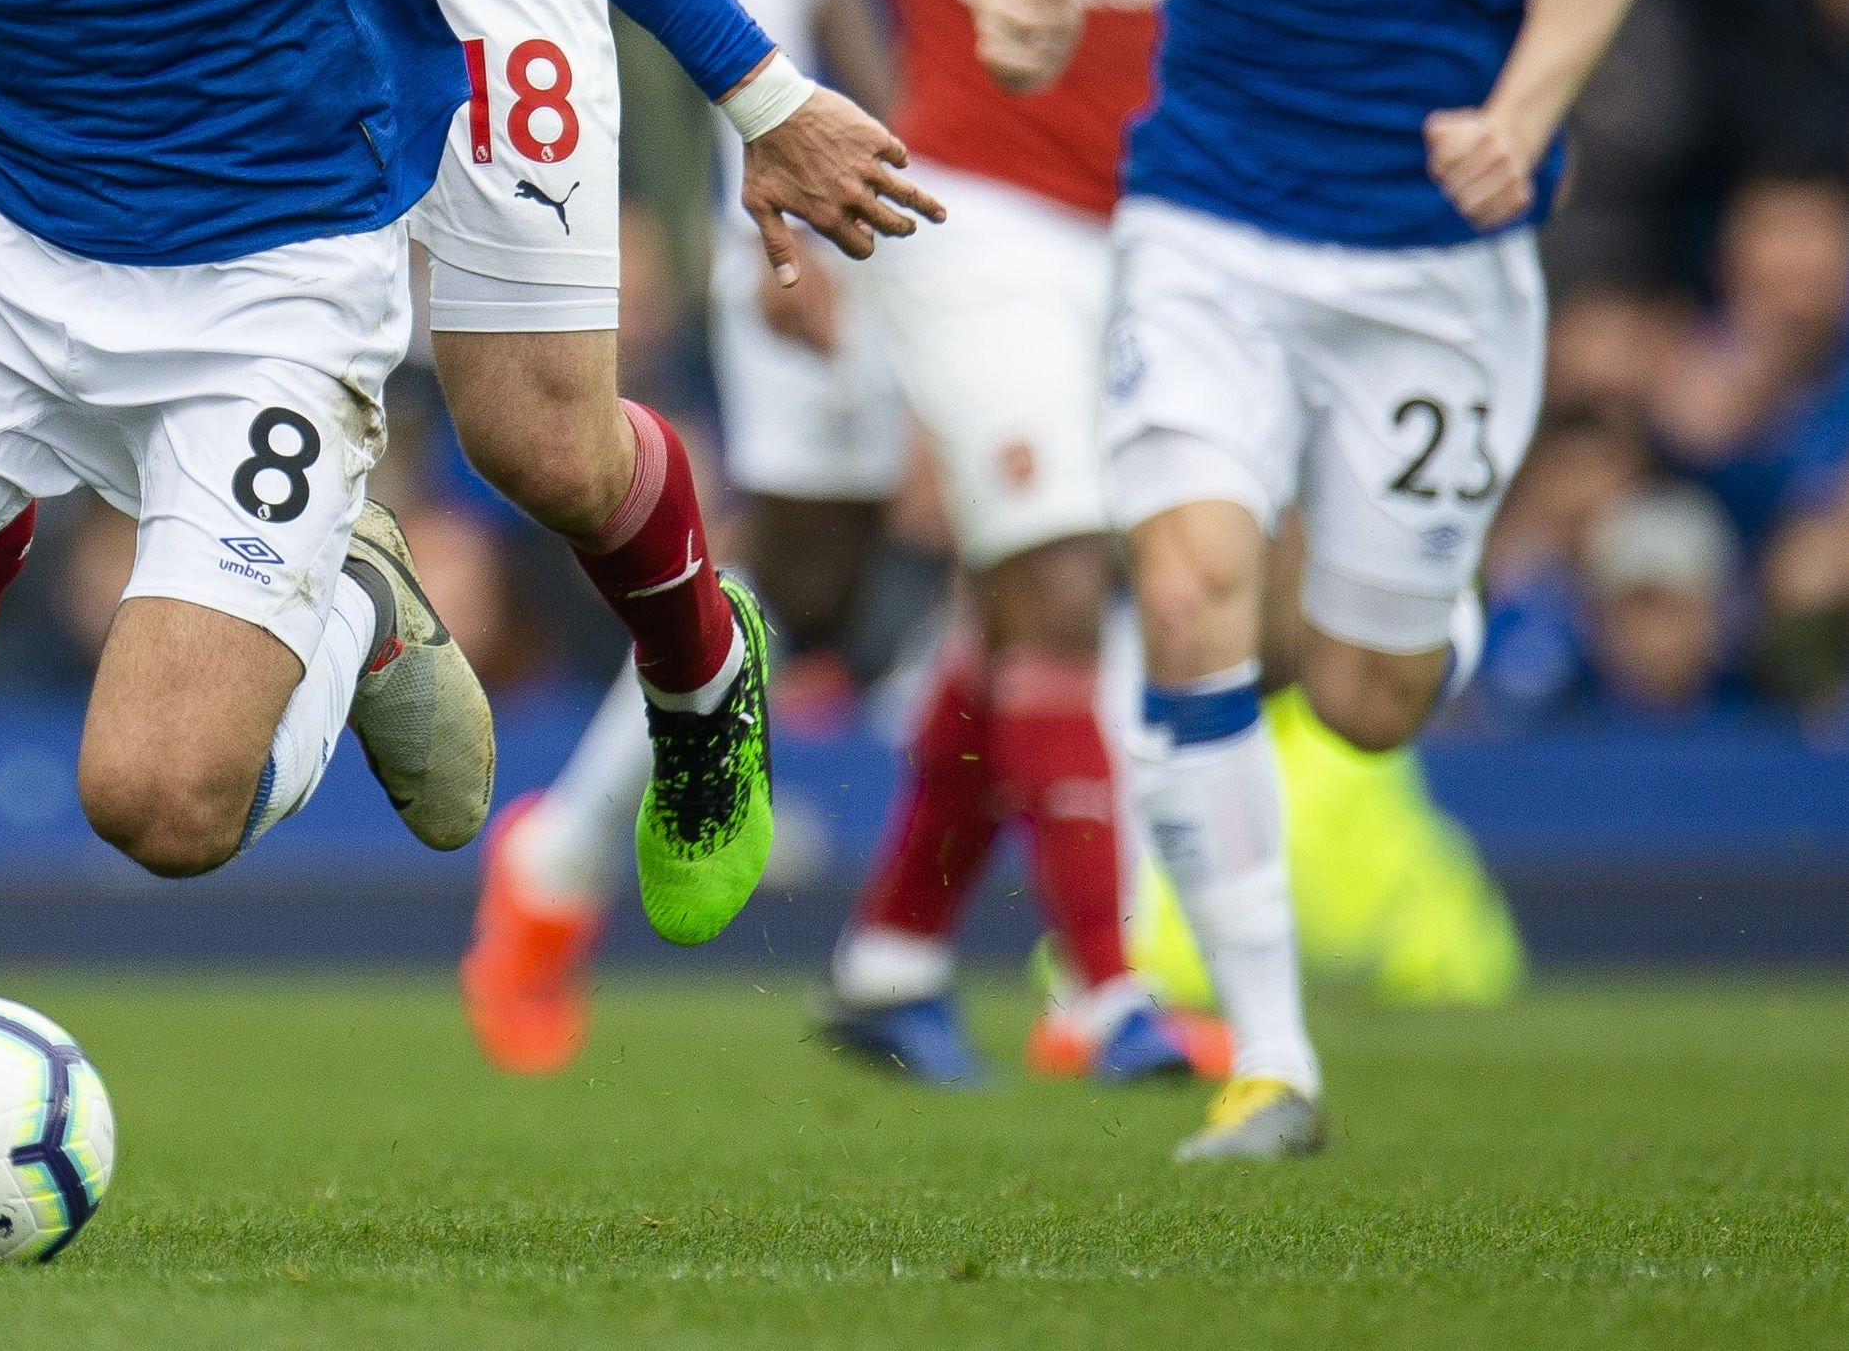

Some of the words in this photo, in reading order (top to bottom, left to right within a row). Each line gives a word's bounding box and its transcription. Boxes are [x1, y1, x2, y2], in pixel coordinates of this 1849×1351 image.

[461, 38, 581, 165] 18
[231, 406, 321, 524] 8
[1387, 395, 1498, 507] 23
[218, 557, 272, 586] umbro
